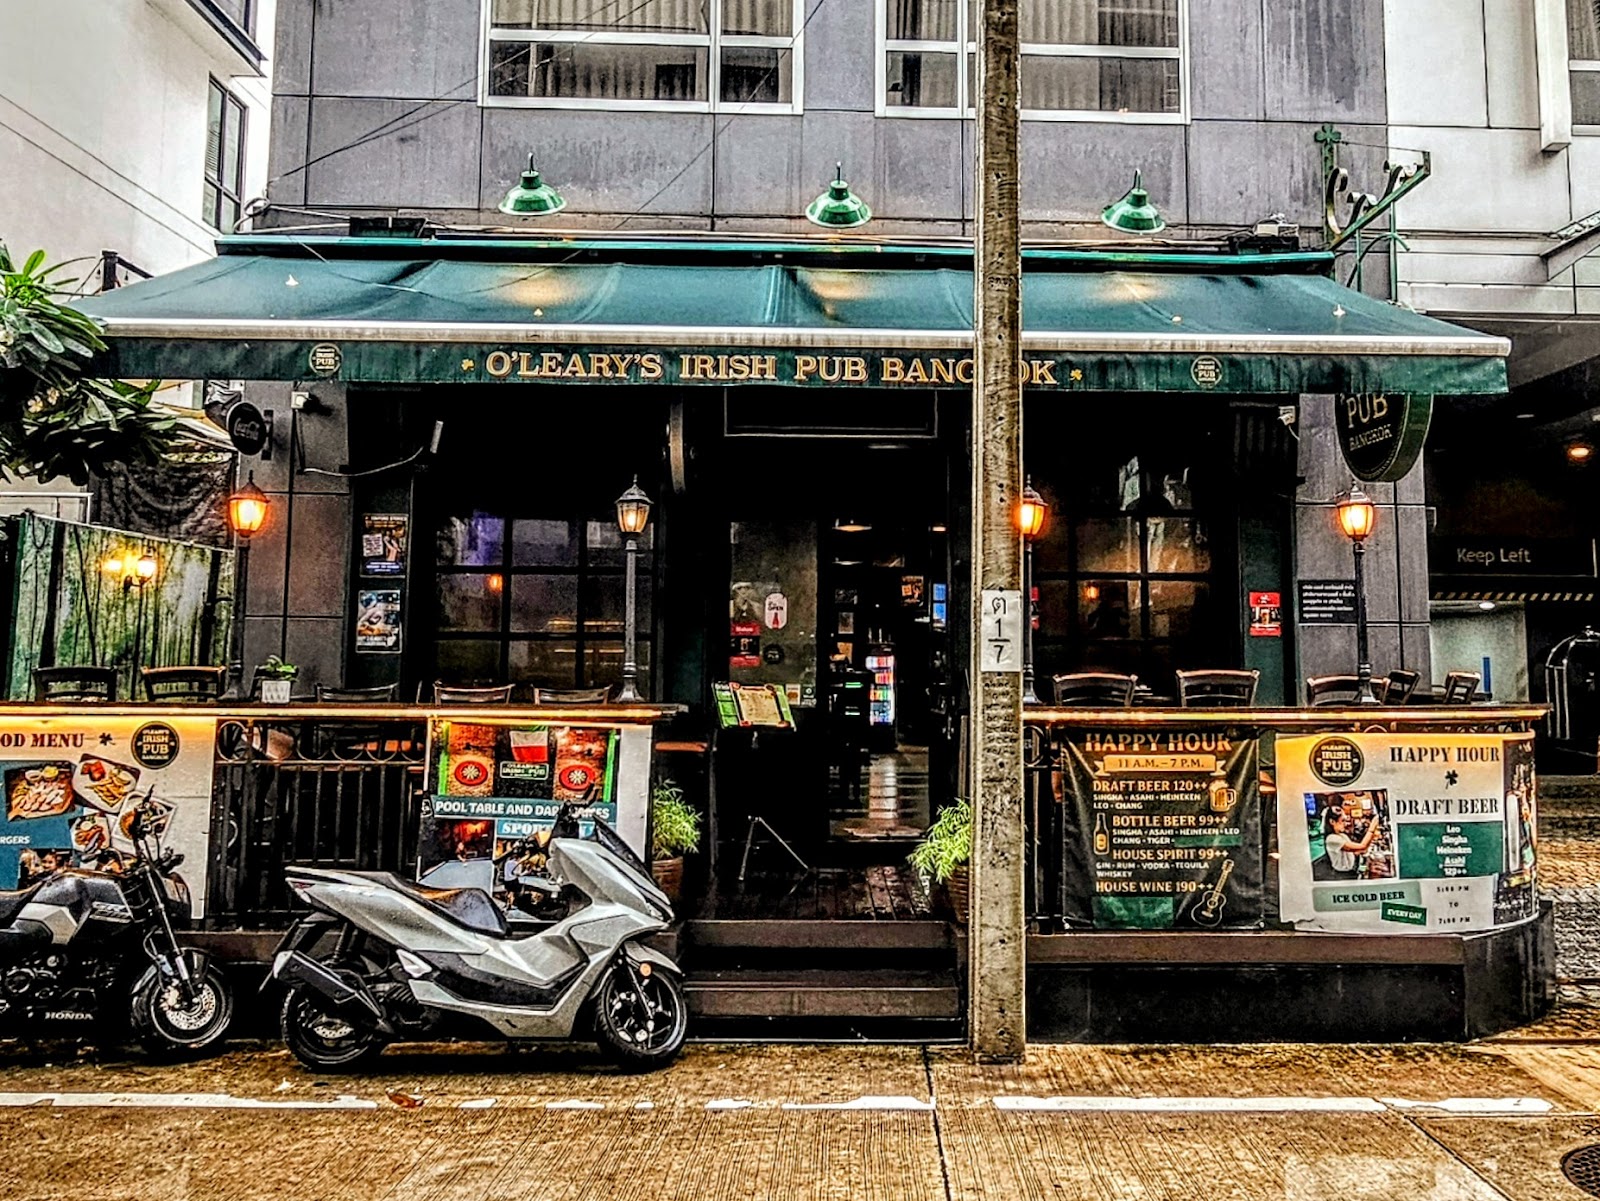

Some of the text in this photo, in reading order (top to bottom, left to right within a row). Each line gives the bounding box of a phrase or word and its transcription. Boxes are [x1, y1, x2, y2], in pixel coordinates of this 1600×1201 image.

[485, 350, 664, 380] O'LEARY'S
[678, 353, 778, 381] IRISH
[793, 355, 869, 382] PUB
[1346, 392, 1388, 429] PUB
[1456, 547, 1532, 567] Keep Left
[31, 733, 85, 748] MENU
[142, 735, 169, 743] IRISH
[1085, 733, 1232, 752] HAPPY HOUR
[142, 744, 169, 754] PUB
[1321, 751, 1352, 759] IRISH
[1389, 746, 1451, 762] HAPPY
[1456, 746, 1500, 762] HOUR
[1118, 759, 1128, 768] 11
[1133, 759, 1159, 768] A.M.
[1181, 758, 1205, 768] P.M.
[1322, 760, 1352, 771] PUB
[1093, 780, 1208, 792] DRAFT BEER 120++
[1160, 793, 1201, 801] HEINEKEN
[435, 800, 468, 814] POOL
[469, 802, 504, 815] TABLE
[506, 804, 534, 816] AND
[1093, 802, 1143, 810] LEO CHANG
[1395, 797, 1499, 815] DRAFT BEER
[1112, 815, 1229, 827] BOTTLE BEER 99++
[1112, 828, 1144, 836] SINGHA
[1149, 828, 1174, 836] ASAHI
[1179, 828, 1219, 836] HEINEKEN
[1446, 825, 1461, 833] Leo
[1112, 836, 1171, 845] CHANG TIGER
[1112, 848, 1229, 860] HOUSE SPIRIT 99++
[1096, 881, 1214, 893] HOUSE WINE 190++
[1332, 891, 1406, 904] ICE COLD BEER
[45, 1012, 94, 1020] HONDA
